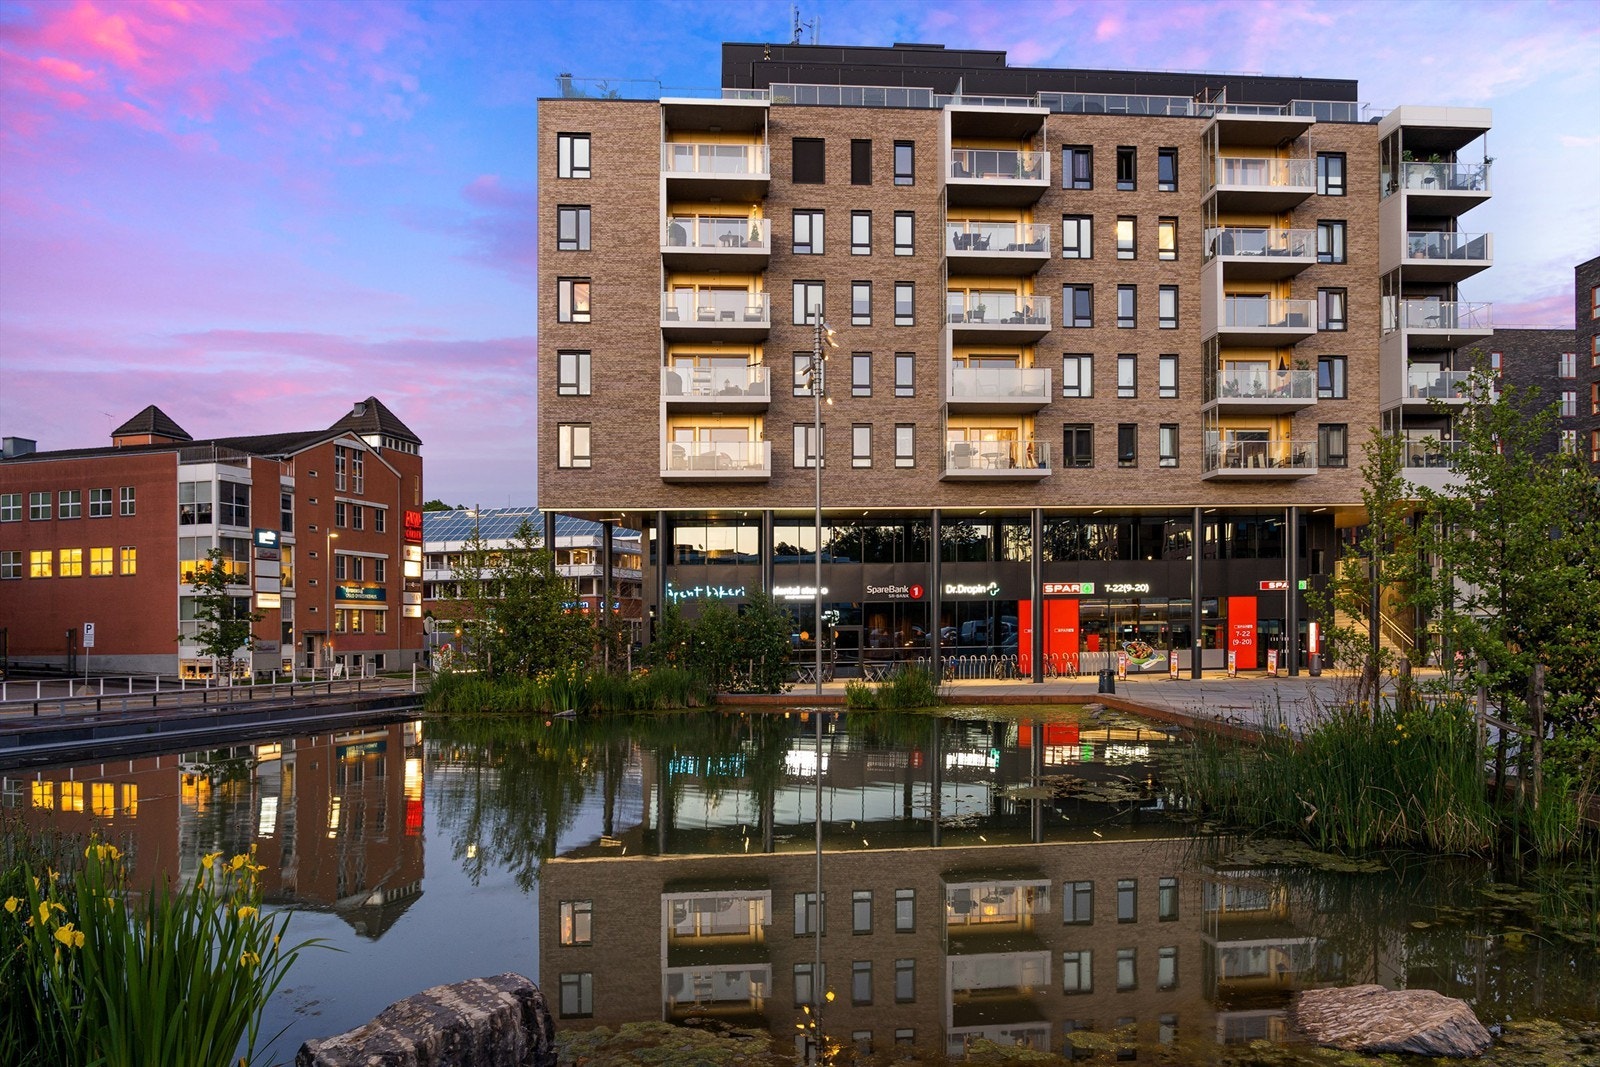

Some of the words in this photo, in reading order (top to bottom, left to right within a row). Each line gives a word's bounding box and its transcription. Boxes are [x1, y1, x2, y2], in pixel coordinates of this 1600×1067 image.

[706, 585, 745, 599] bakeri
[866, 585, 909, 595] SpareBank
[945, 584, 986, 595] Dr.Dropin
[1045, 584, 1080, 593] SPAR
[86, 624, 93, 634] P
